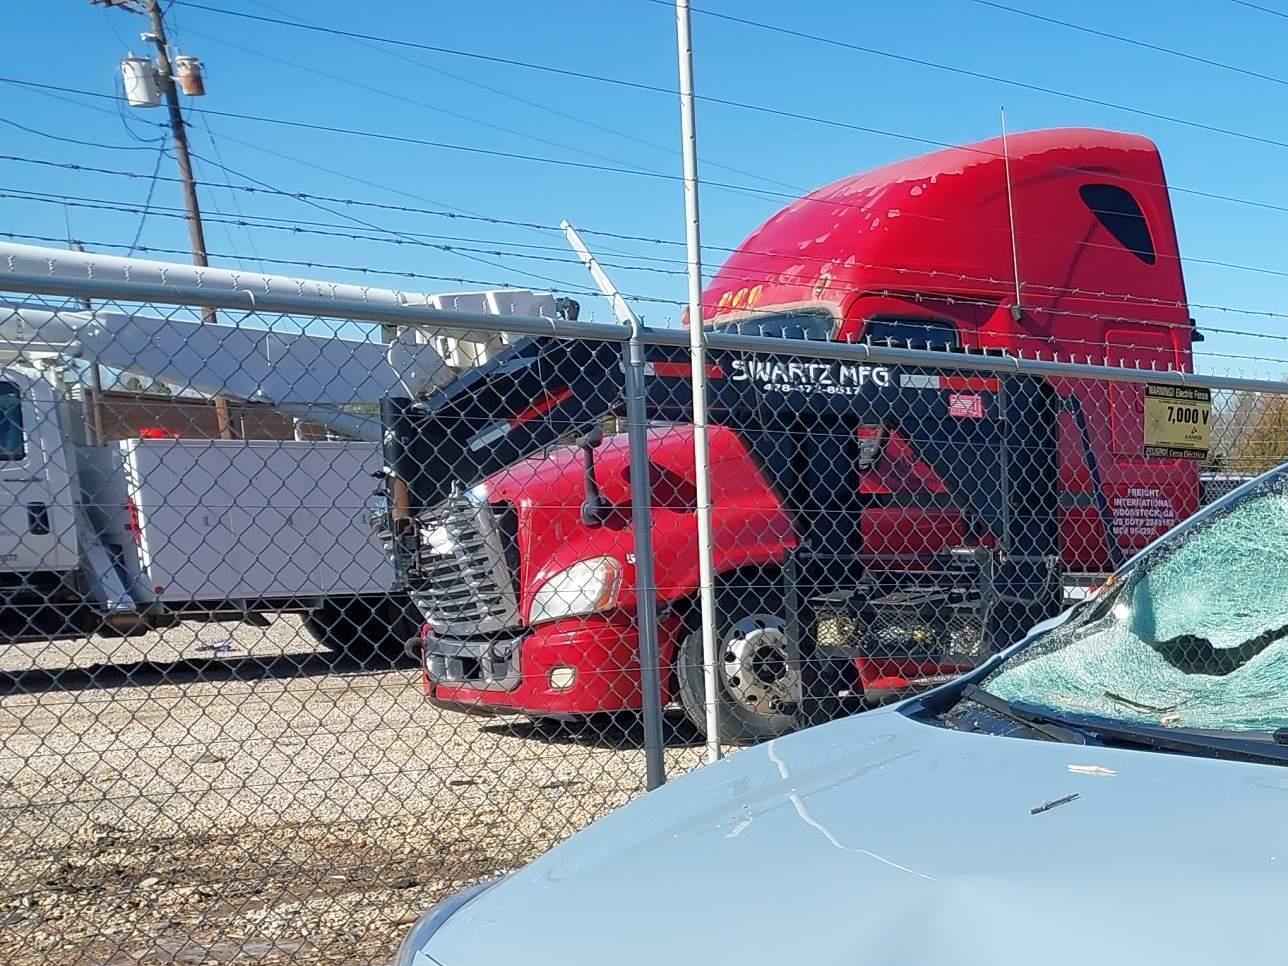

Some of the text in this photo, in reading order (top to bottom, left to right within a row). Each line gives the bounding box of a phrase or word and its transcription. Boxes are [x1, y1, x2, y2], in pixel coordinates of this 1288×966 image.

[731, 359, 890, 388] SWARTZ MFG
[1167, 405, 1210, 425] 7,000 V
[1127, 488, 1160, 497] FREIGHT
[1163, 509, 1174, 518] GA
